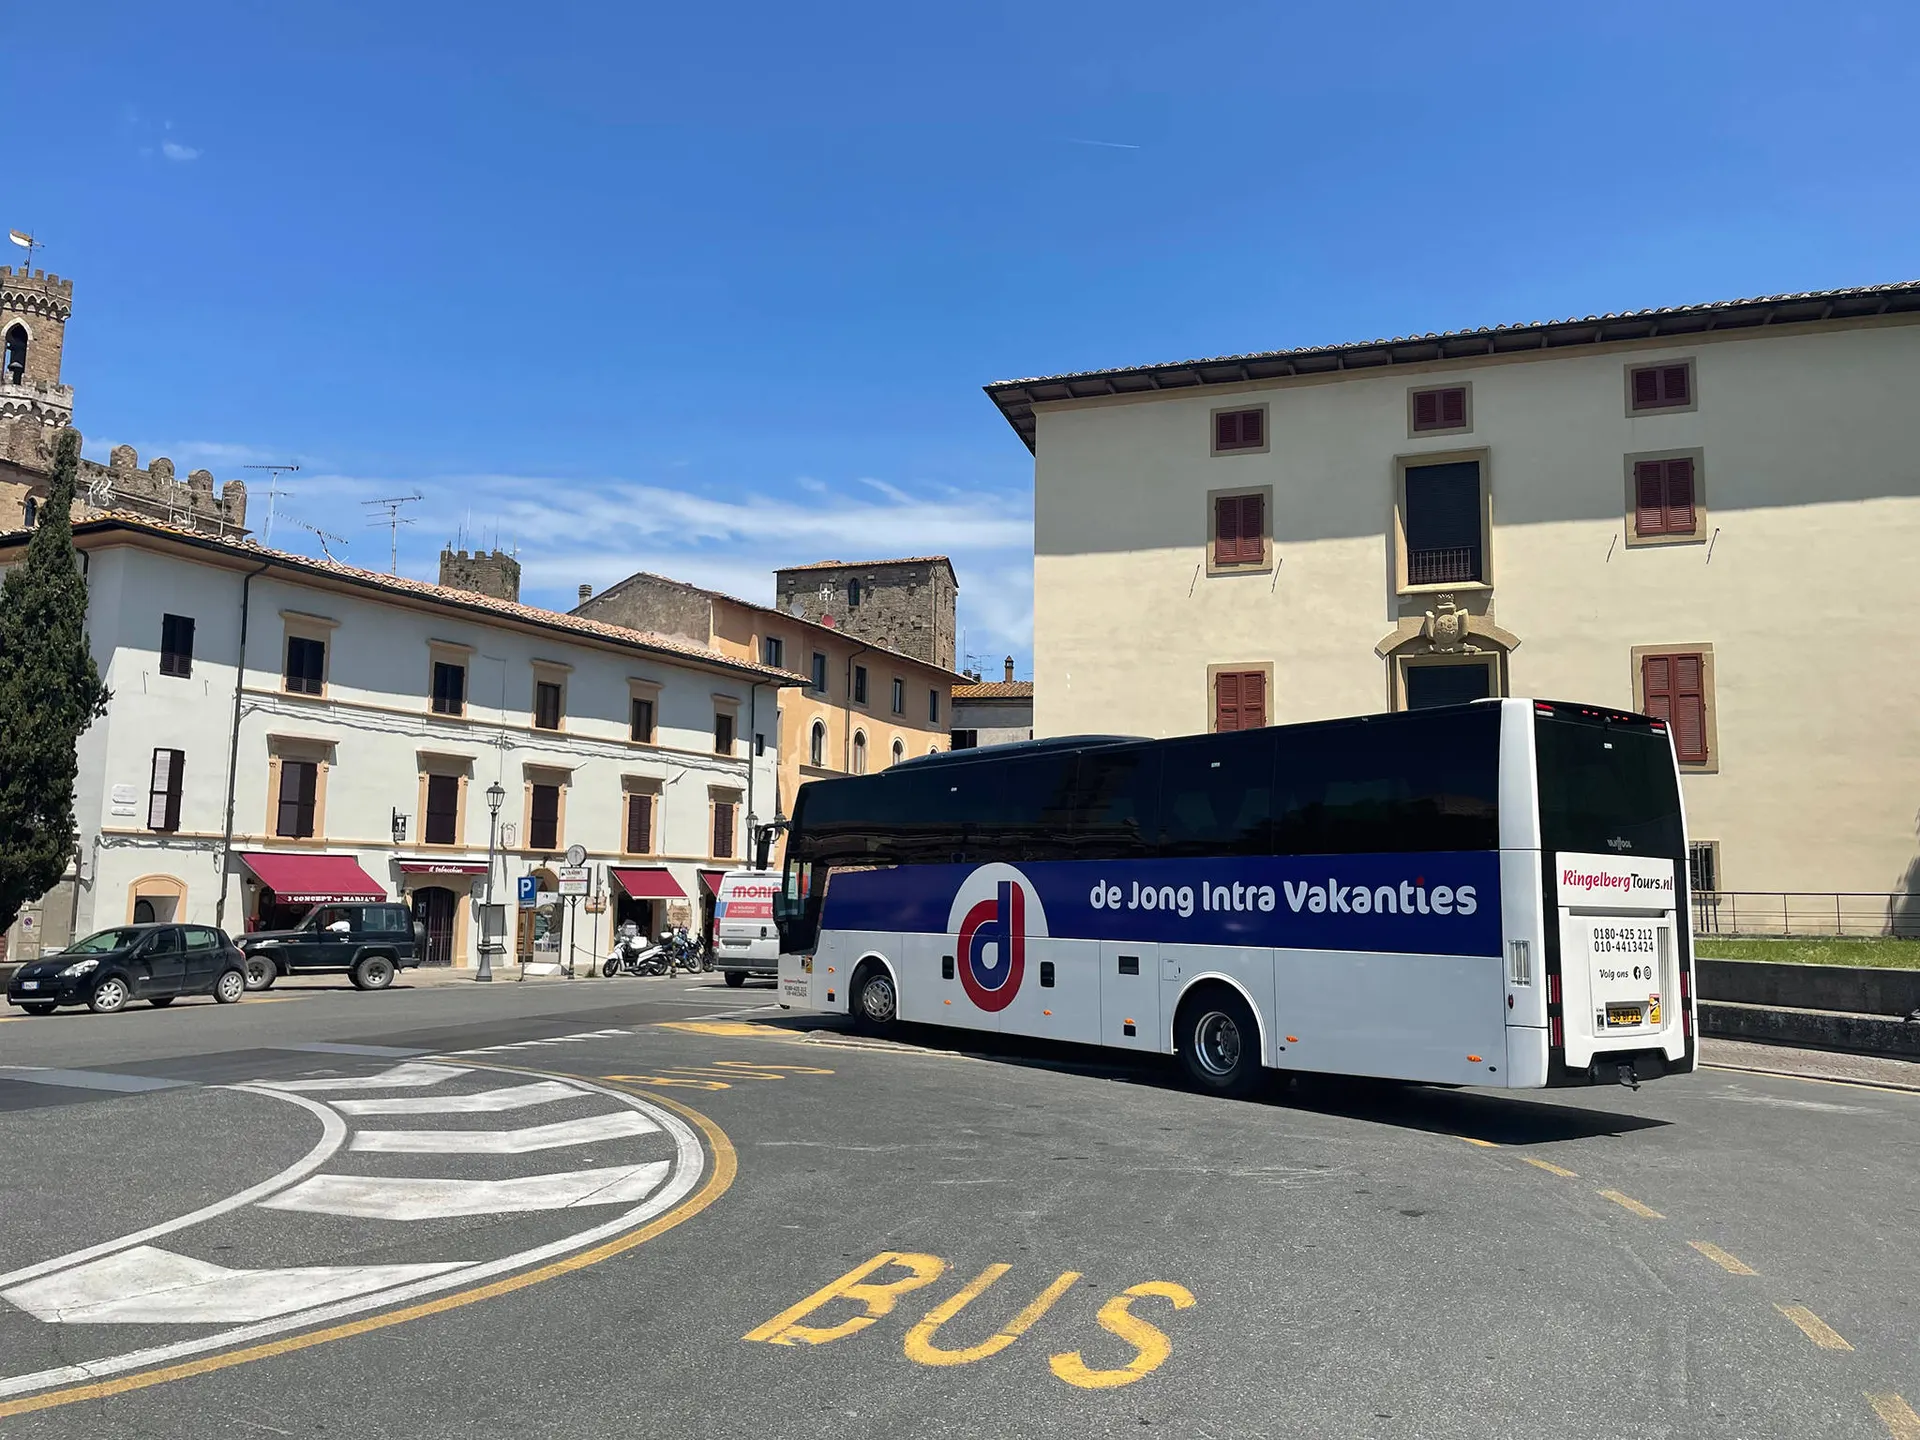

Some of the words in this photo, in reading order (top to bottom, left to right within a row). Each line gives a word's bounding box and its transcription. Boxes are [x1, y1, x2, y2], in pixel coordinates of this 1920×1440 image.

[521, 879, 532, 898] P
[1563, 869, 1673, 893] RingelbergTours.nl
[1089, 879, 1122, 910] de
[1127, 880, 1194, 918] Jong
[1202, 880, 1276, 912] Intra
[1283, 876, 1477, 915] Vakanties
[1594, 928, 1635, 940] 0180-425
[1637, 928, 1653, 940] 212
[1594, 940, 1654, 953] 010-4413424
[1599, 969, 1615, 981] Volg
[1616, 970, 1629, 978] ons
[741, 1251, 1197, 1390] BUS
